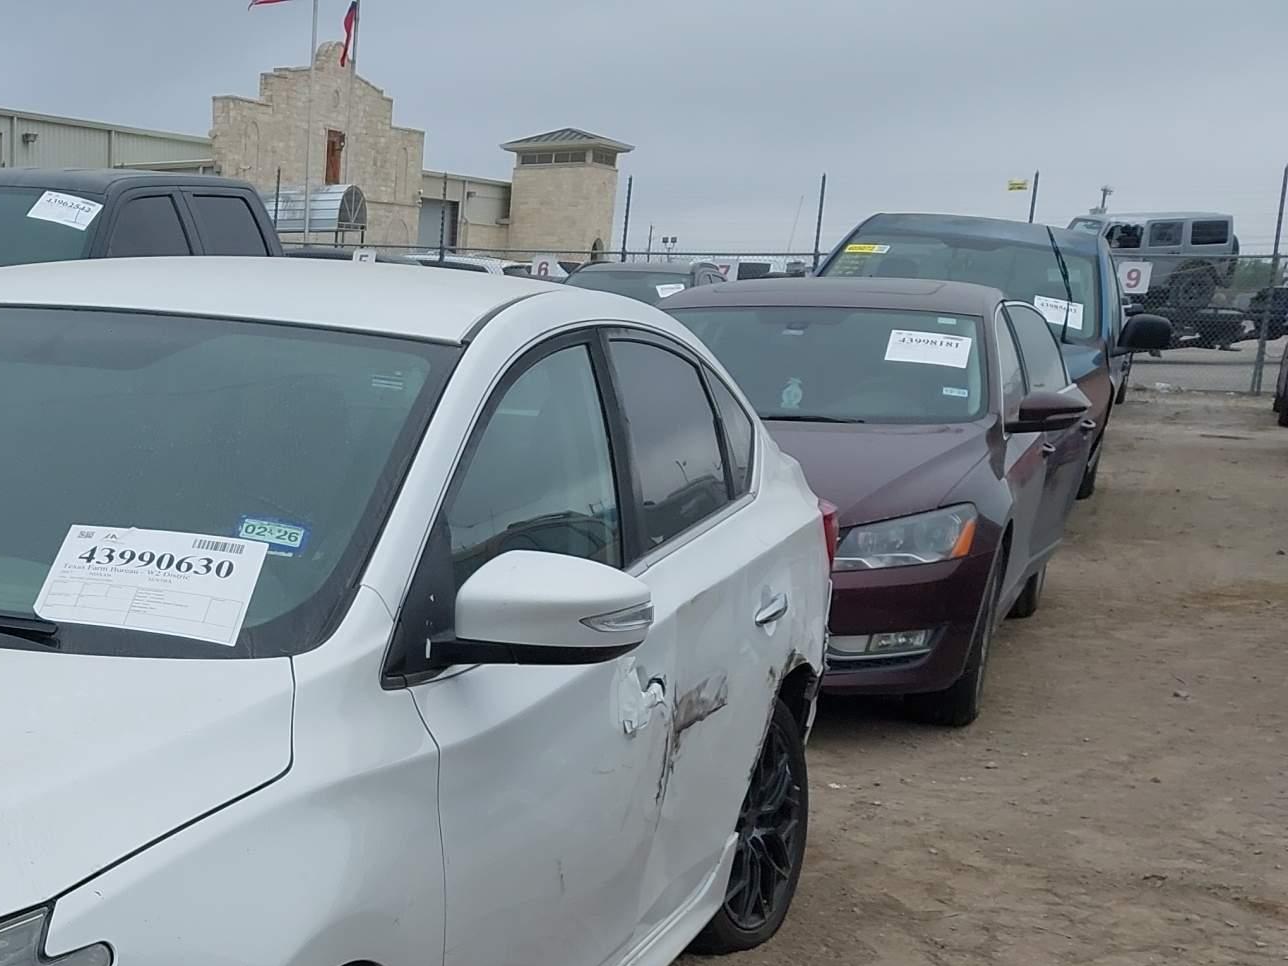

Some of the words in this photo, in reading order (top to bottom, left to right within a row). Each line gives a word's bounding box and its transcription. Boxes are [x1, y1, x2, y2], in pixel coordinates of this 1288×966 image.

[1126, 268, 1142, 289] 9
[244, 524, 268, 537] 02
[275, 530, 299, 543] 26
[78, 545, 234, 578] 43990630
